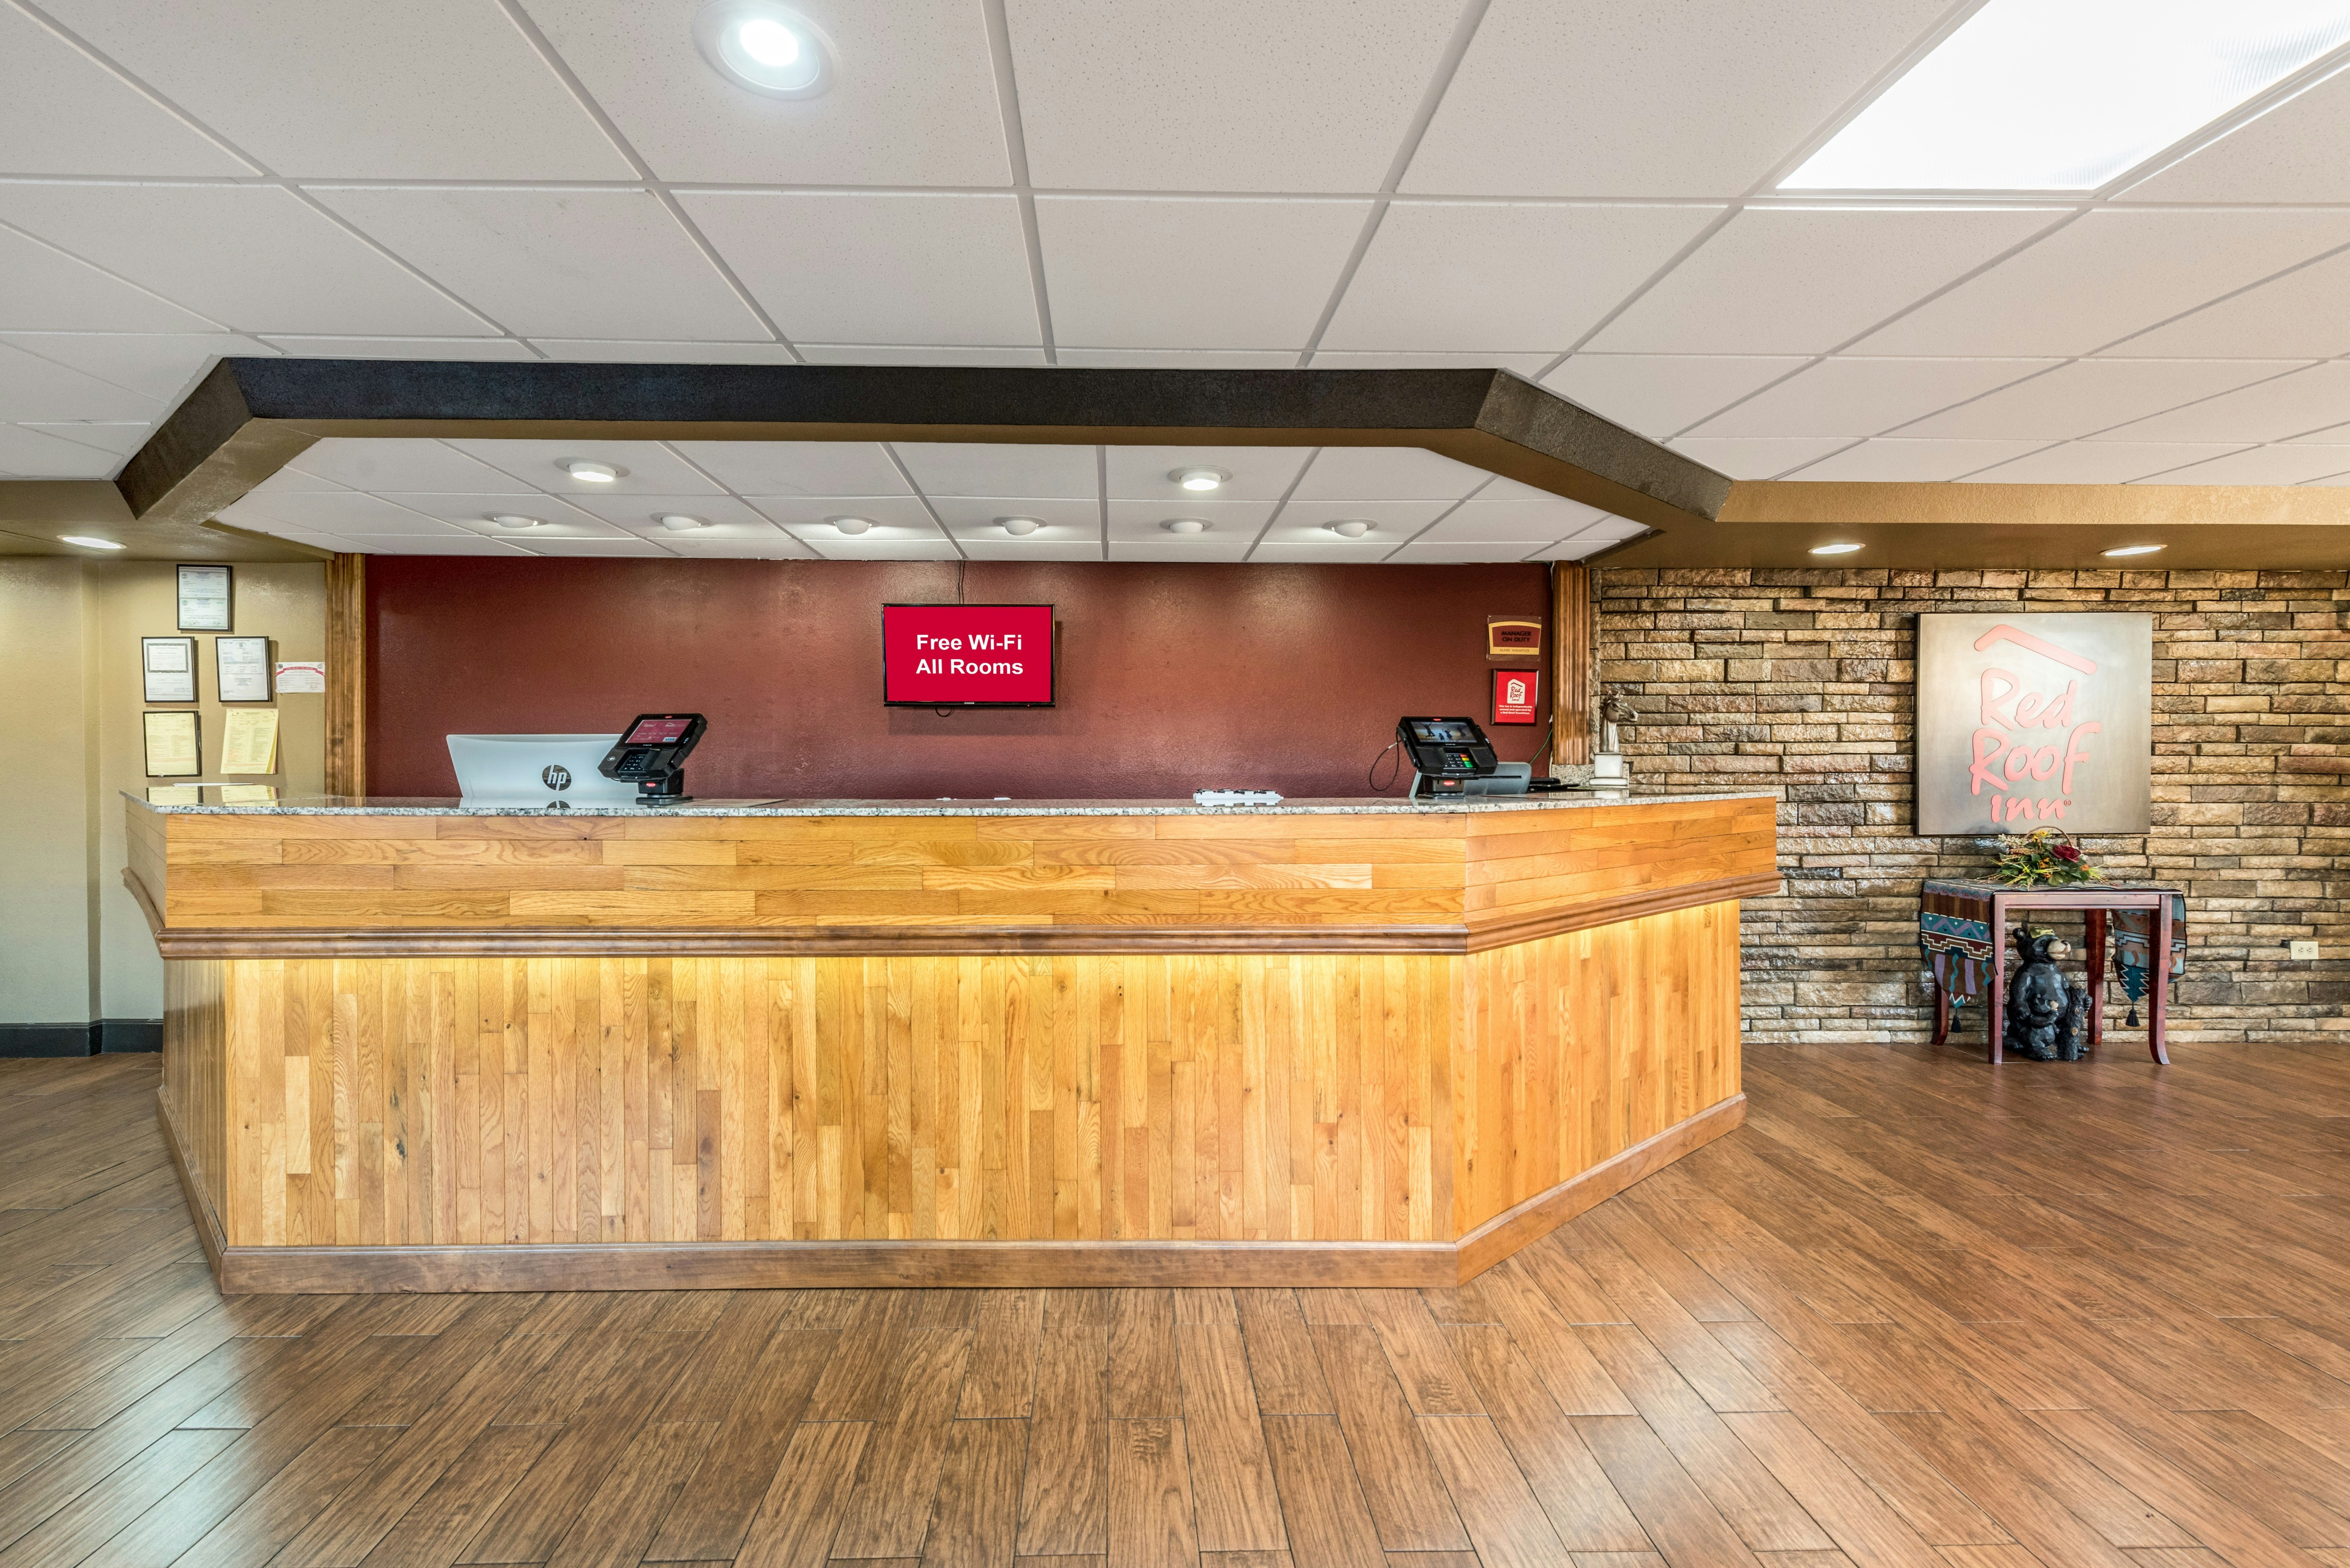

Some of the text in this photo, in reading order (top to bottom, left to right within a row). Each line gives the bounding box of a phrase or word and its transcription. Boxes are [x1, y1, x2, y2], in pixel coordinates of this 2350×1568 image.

[917, 634, 1022, 650] Free Wi-Fi
[916, 658, 1023, 675] All Rooms
[1980, 668, 2078, 730] Red
[1969, 721, 2101, 795] Roof
[547, 764, 567, 791] hp
